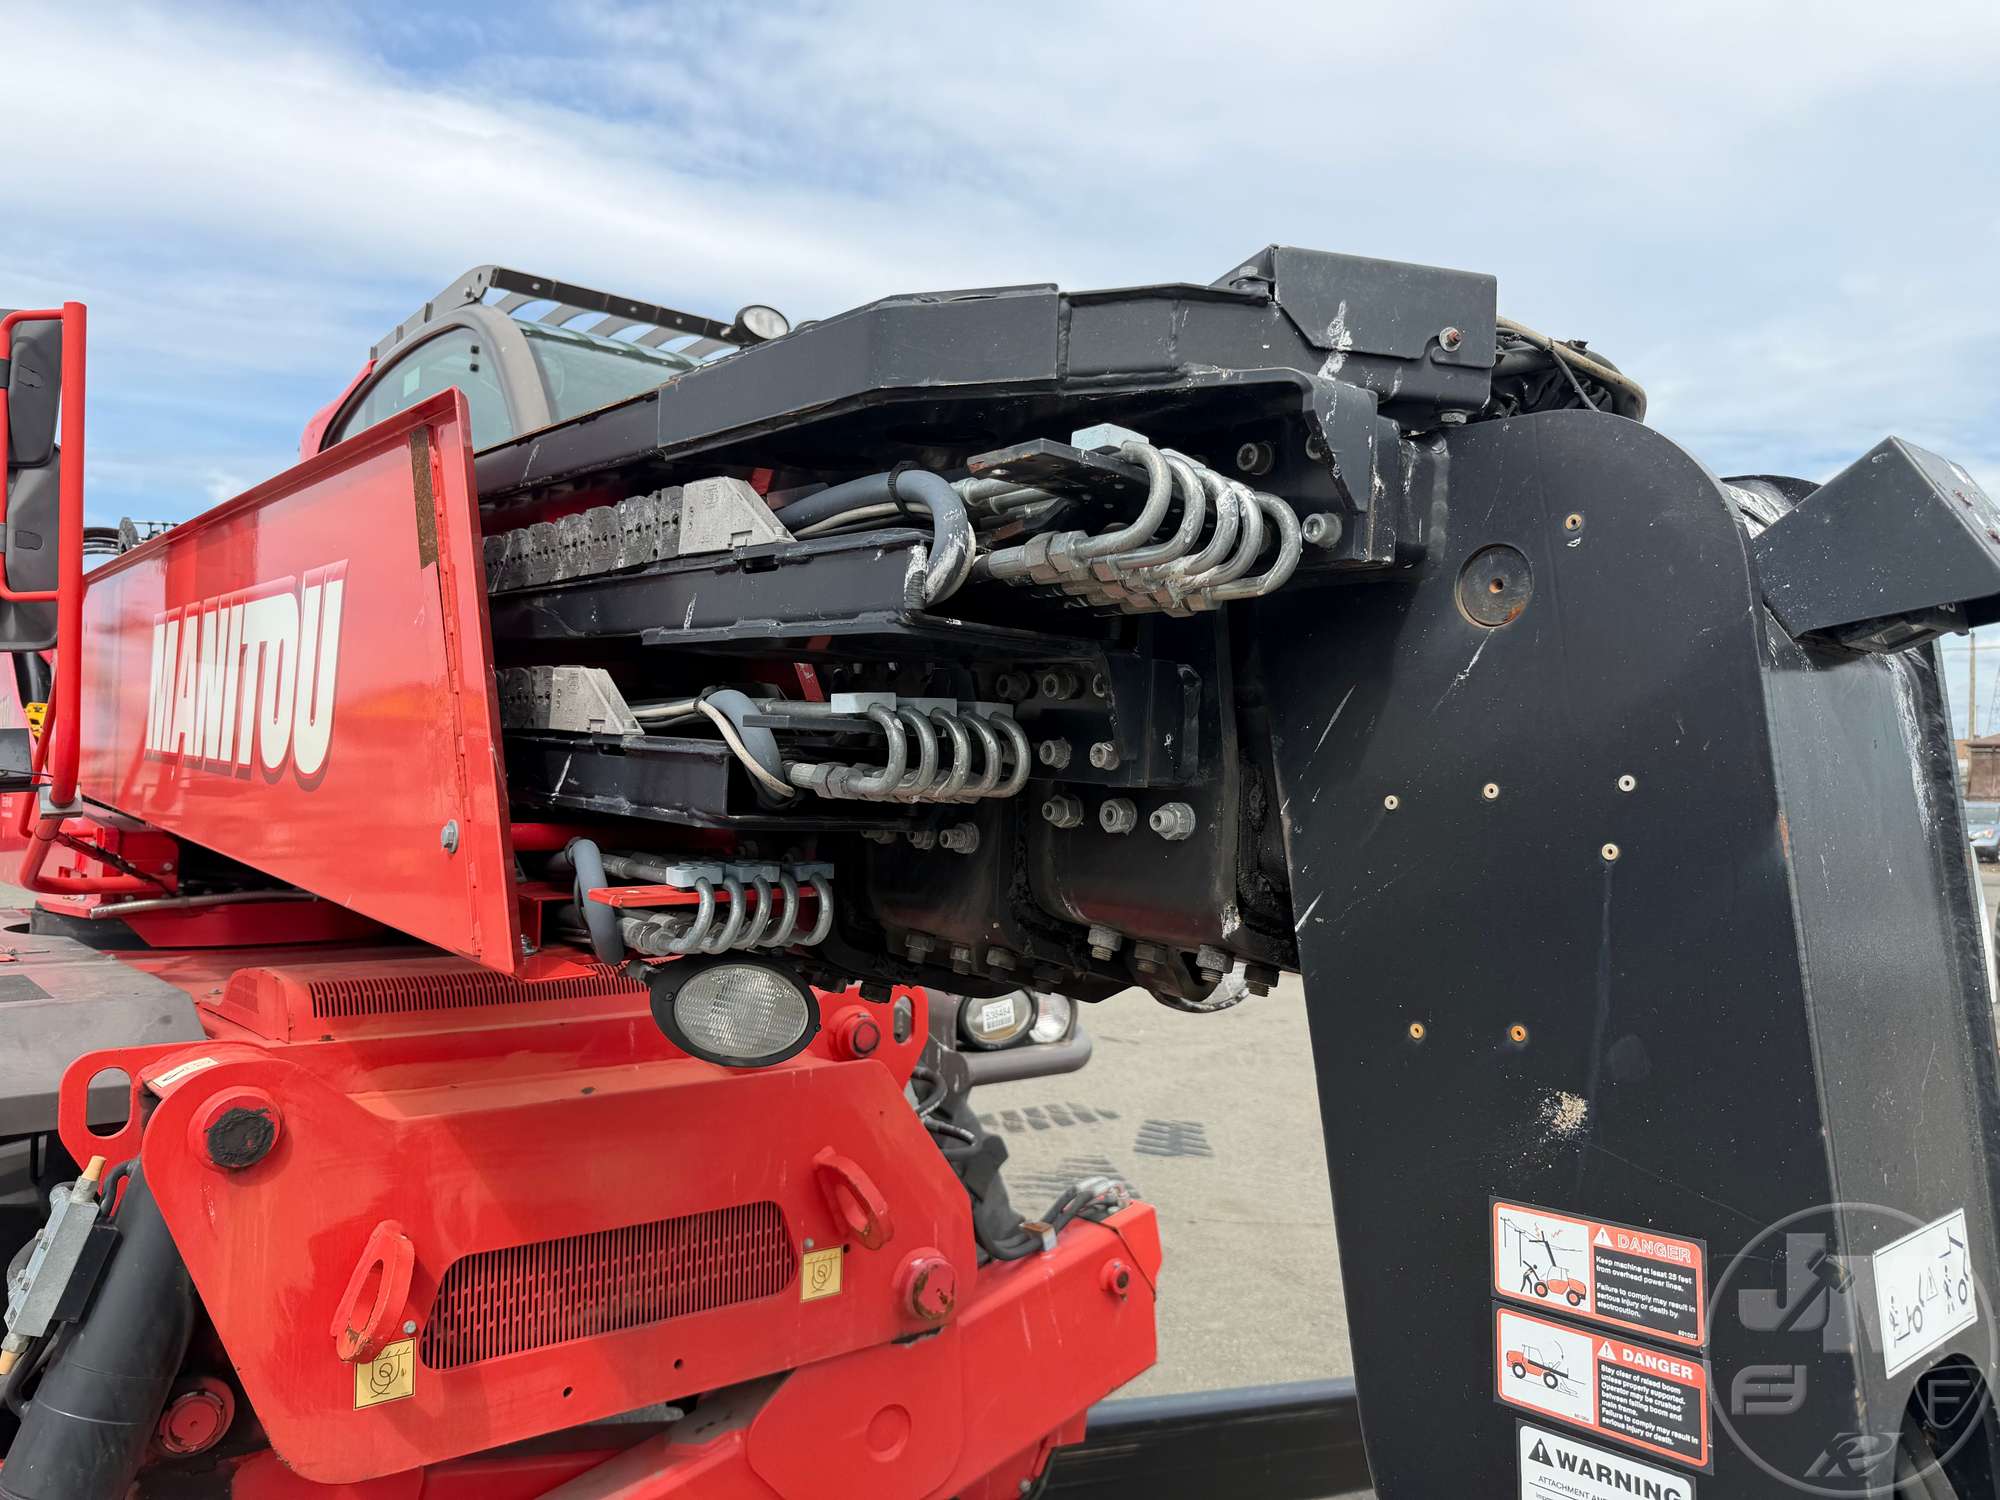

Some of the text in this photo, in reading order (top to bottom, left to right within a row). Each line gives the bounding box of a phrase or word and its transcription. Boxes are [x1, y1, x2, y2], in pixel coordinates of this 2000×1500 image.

[145, 570, 346, 784] MANITOU
[1617, 1234, 1692, 1264] DANGER
[1596, 1256, 1692, 1285] Keep machine at least 25 feet
[1596, 1265, 1684, 1292] from overhead power lines.
[1597, 1283, 1618, 1294] Failure
[1619, 1287, 1627, 1295] to
[1627, 1292, 1652, 1304] comply
[1652, 1298, 1667, 1307] may
[1668, 1300, 1689, 1312] result
[1597, 1292, 1679, 1319] serious injury or death by
[1597, 1301, 1641, 1318] electrocution.
[1622, 1349, 1693, 1380] DANGER
[1601, 1365, 1681, 1394] Stay clear of raised boom
[1601, 1375, 1686, 1405] unless properly supported.
[1601, 1382, 1681, 1412] Operator may be crushed
[1601, 1391, 1682, 1421] between falling boom and
[1602, 1401, 1638, 1416] main frame.
[1602, 1408, 1623, 1420] Failure
[1624, 1413, 1631, 1422] to
[1631, 1417, 1656, 1431] comply
[1656, 1425, 1671, 1436] may
[1671, 1430, 1691, 1443] result
[1691, 1435, 1699, 1444] in
[1602, 1417, 1674, 1446] serious injury or death.
[1538, 1475, 1590, 1500] ATTACHMENT
[1555, 1448, 1682, 1500] WARNING
